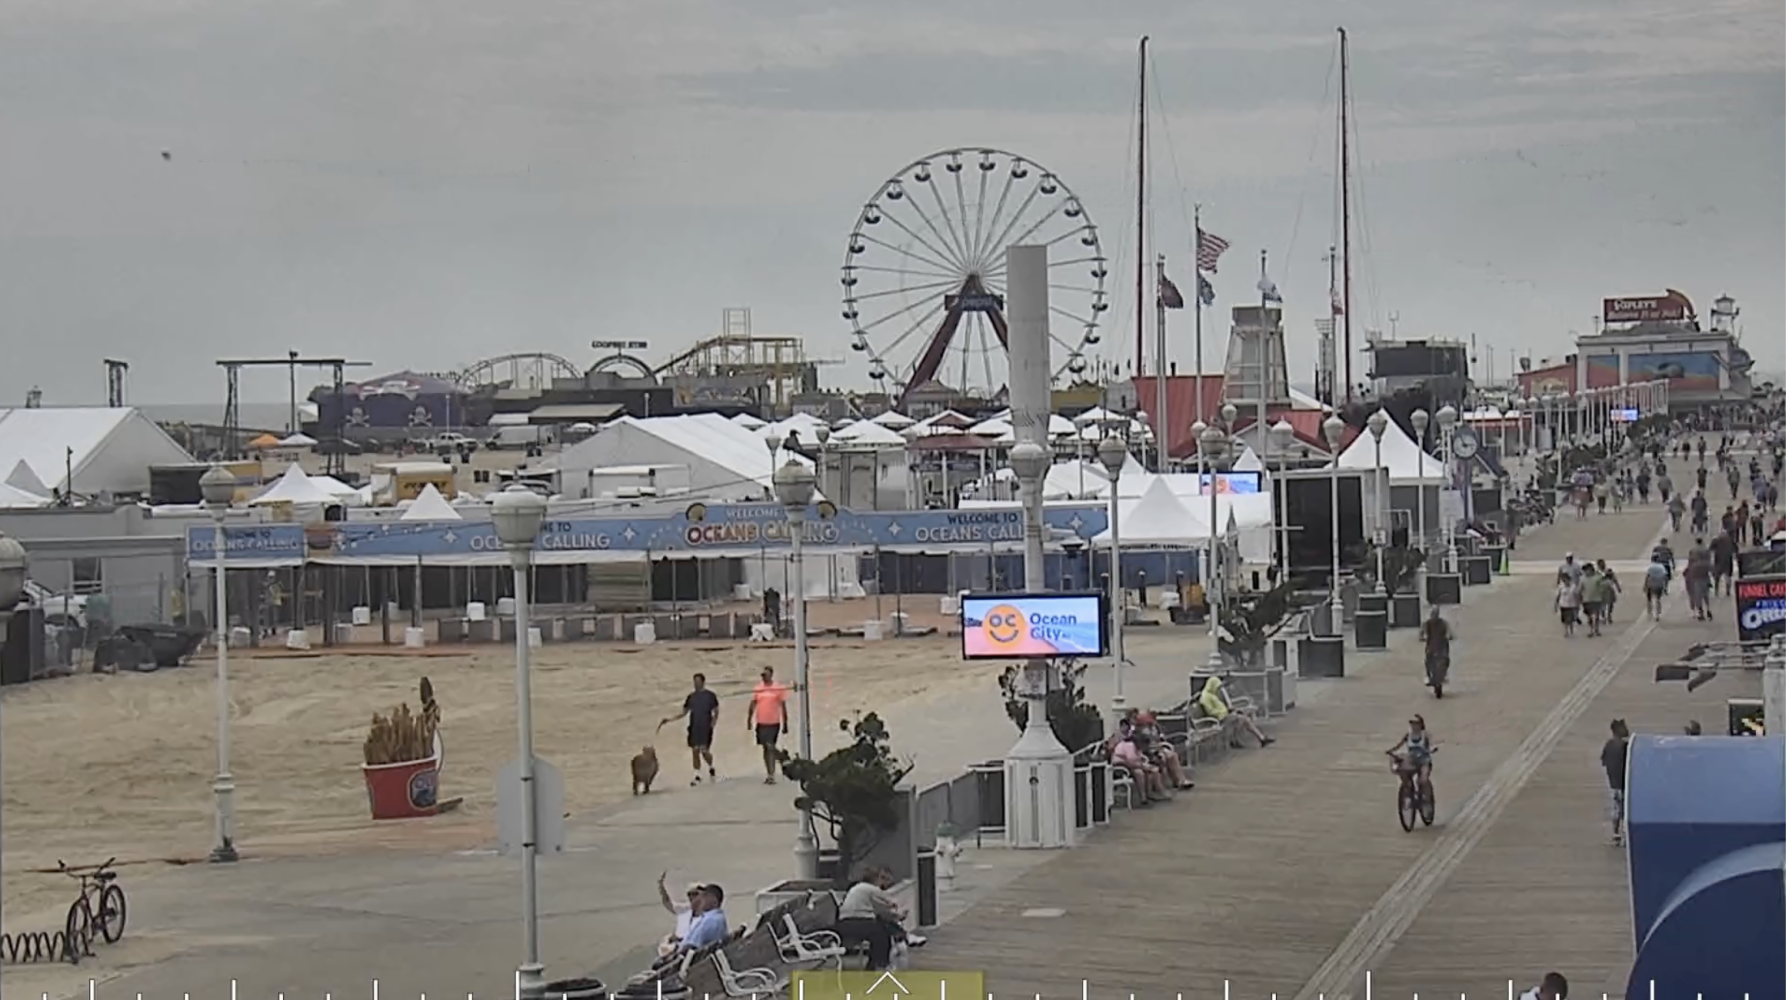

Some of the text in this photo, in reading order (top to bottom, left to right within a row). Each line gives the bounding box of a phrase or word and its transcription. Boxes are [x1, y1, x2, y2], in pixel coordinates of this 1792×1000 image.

[725, 508, 780, 519] WELCOME
[947, 512, 1019, 525] WELCOME TO
[557, 521, 572, 532] TO
[915, 522, 1023, 542] OCEANS CALL
[470, 532, 612, 551] OCE CALLING
[686, 523, 760, 546] OCEANS
[1029, 612, 1077, 626] Ocean
[1029, 627, 1061, 641] City
